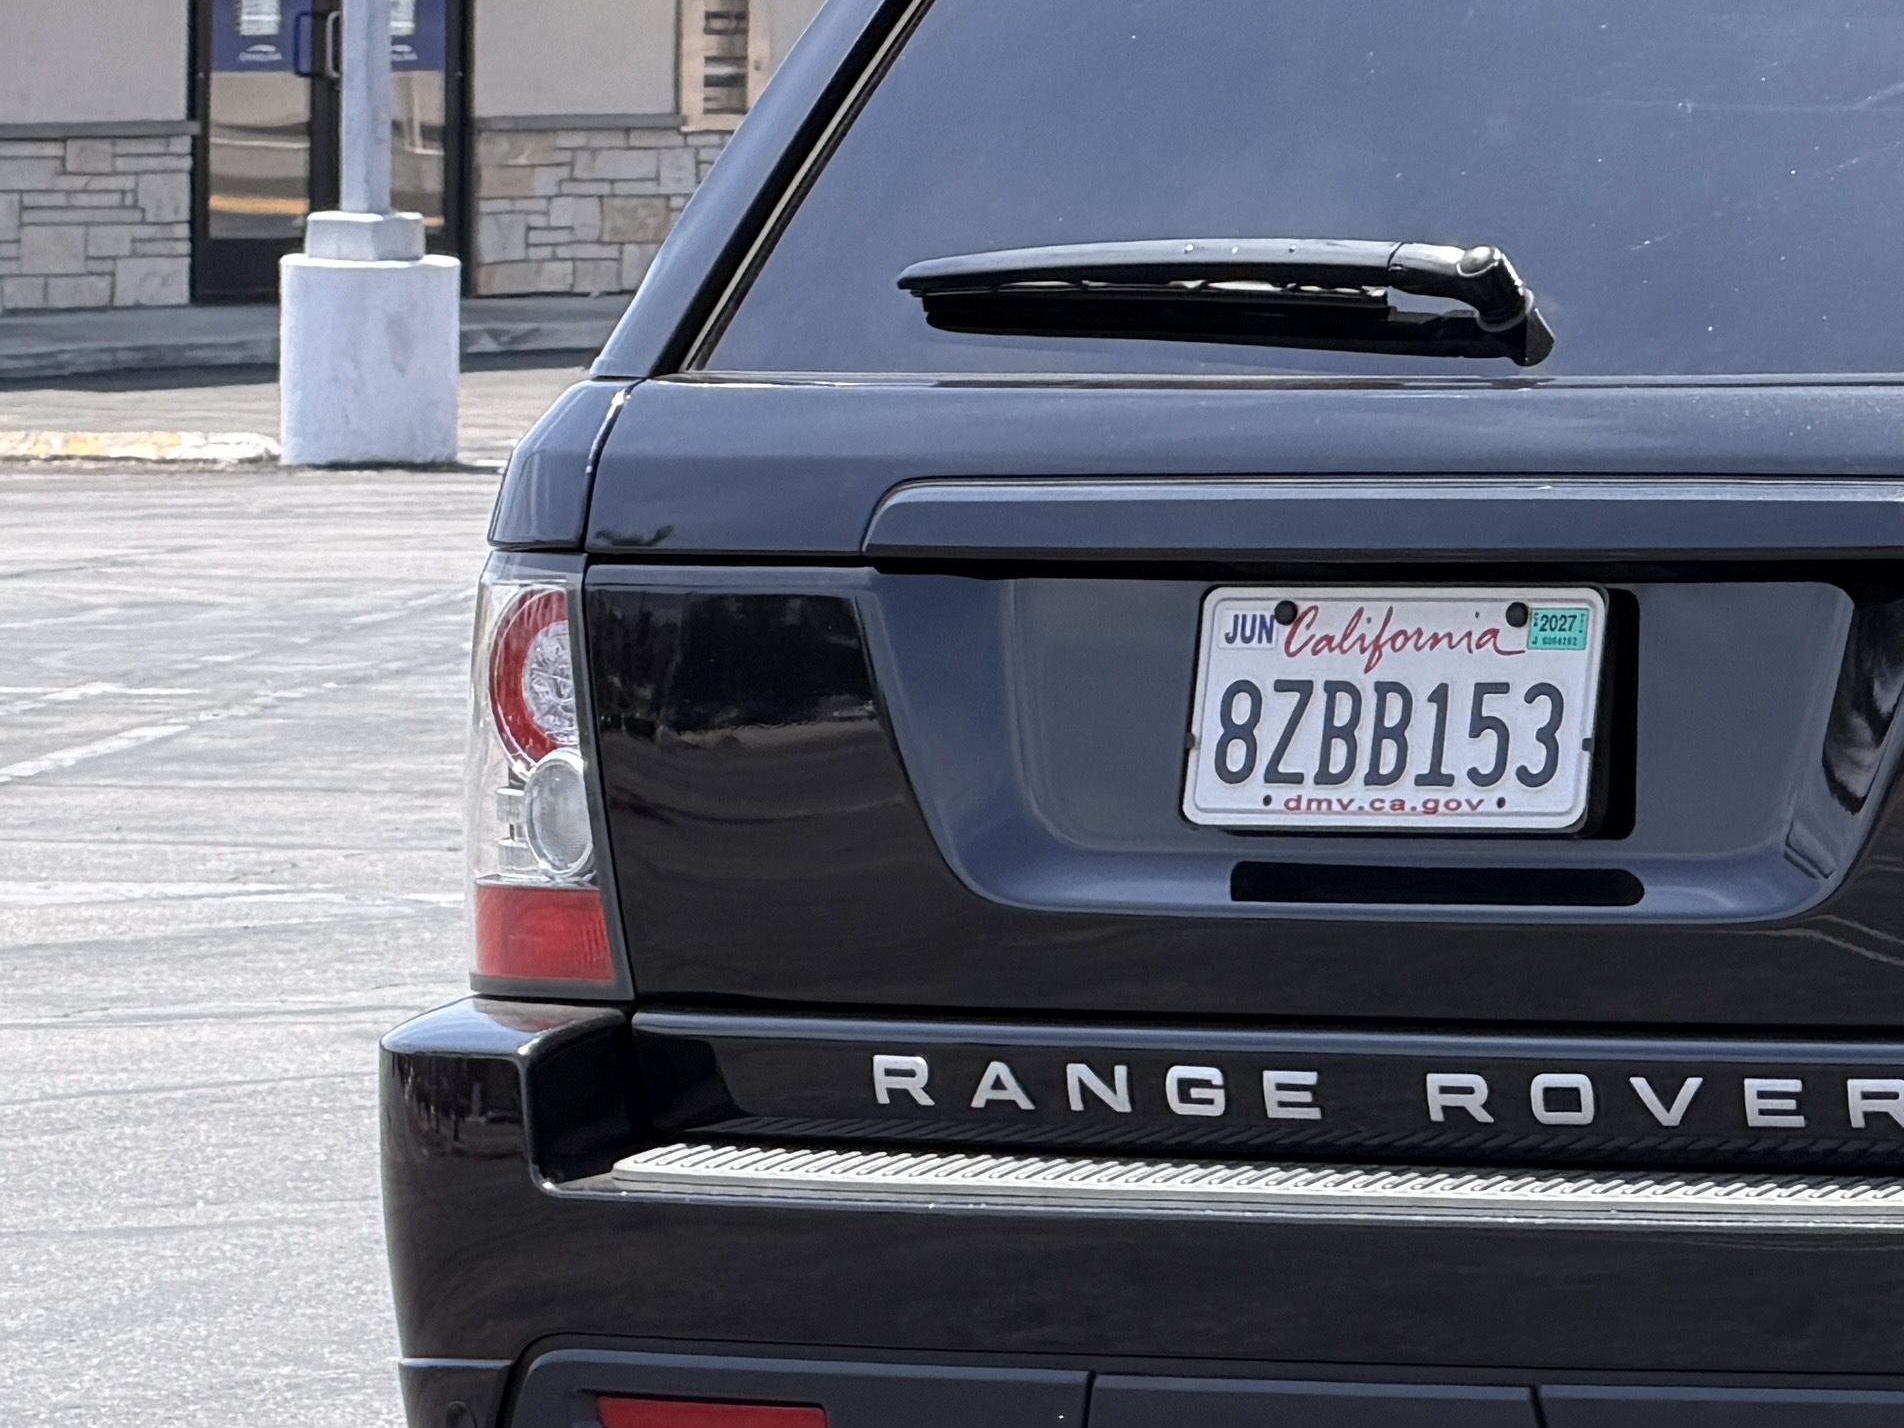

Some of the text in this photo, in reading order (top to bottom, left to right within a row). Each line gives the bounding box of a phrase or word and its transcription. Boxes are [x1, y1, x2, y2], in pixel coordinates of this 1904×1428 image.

[1224, 613, 1276, 645] JUN
[1284, 605, 1526, 674] California
[1539, 615, 1577, 632] 2027
[1214, 679, 1565, 788] 8ZBB153
[1283, 795, 1486, 814] dmv.ca.gov
[871, 1053, 1323, 1121] RANGE
